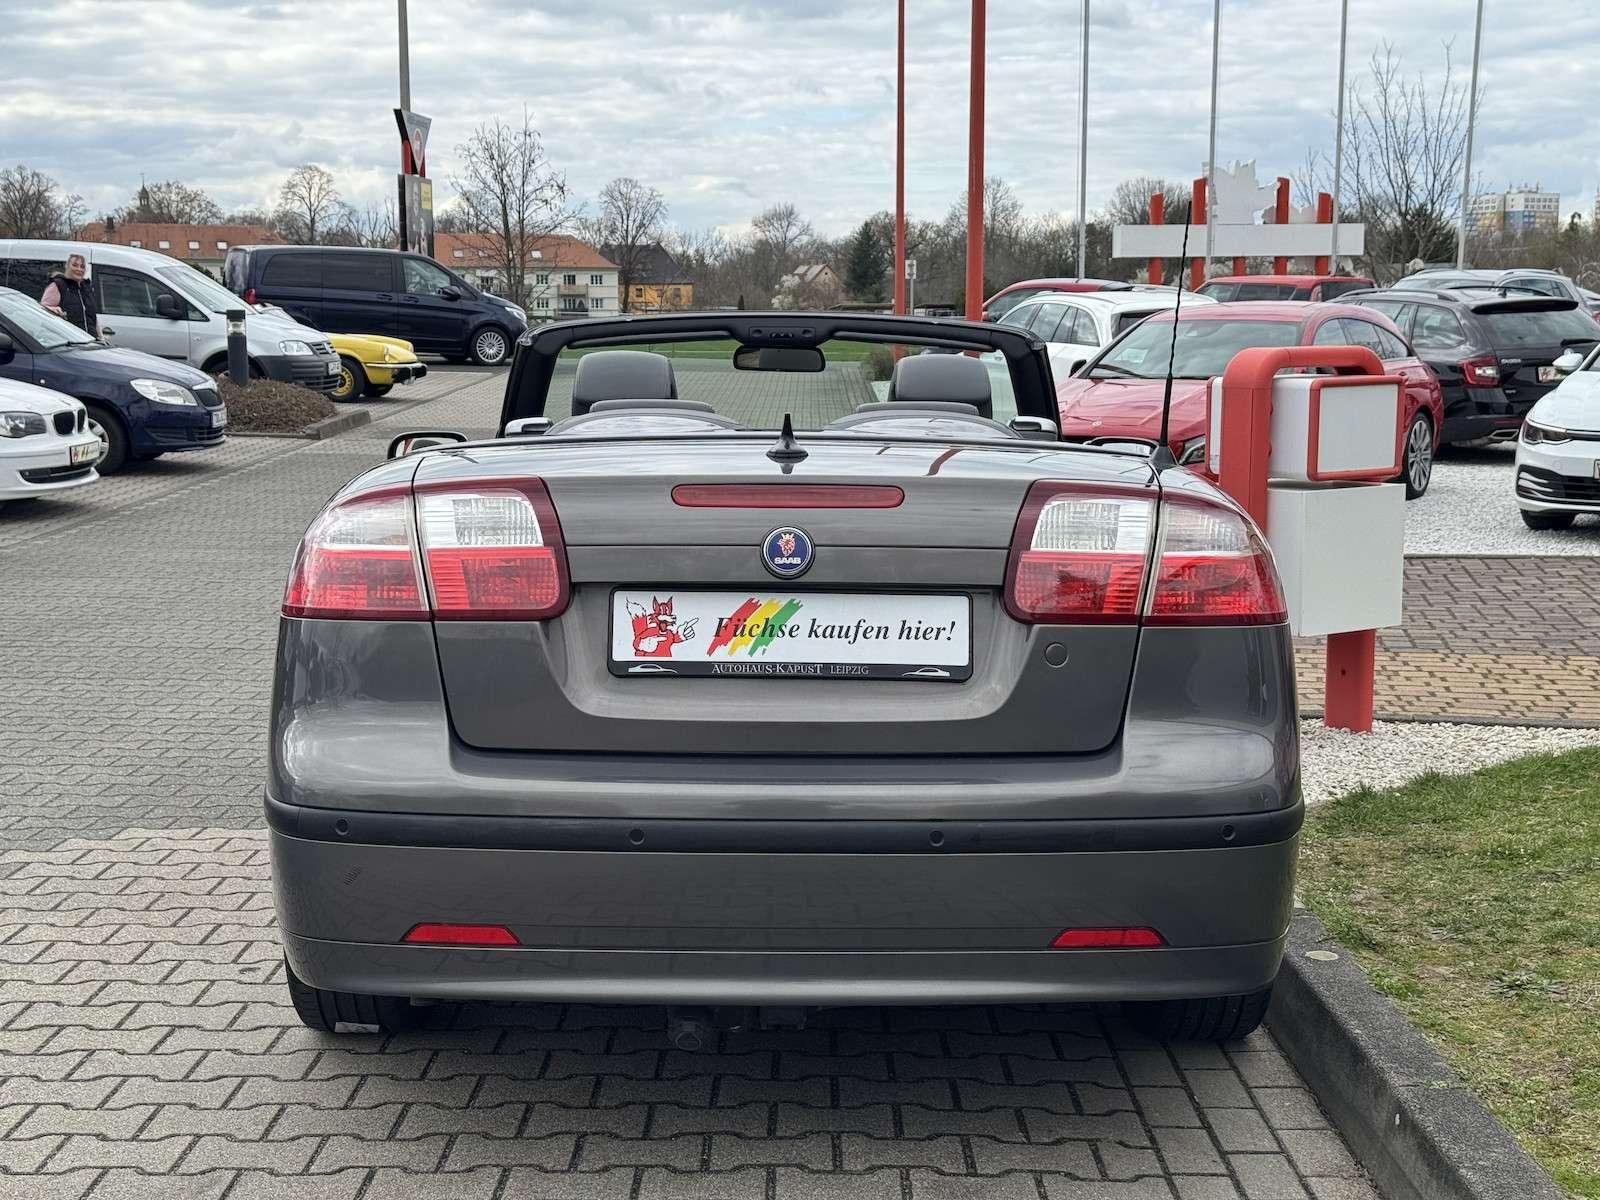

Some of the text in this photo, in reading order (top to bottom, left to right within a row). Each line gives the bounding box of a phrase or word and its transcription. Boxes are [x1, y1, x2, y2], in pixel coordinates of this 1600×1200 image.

[713, 617, 956, 644] Füchse kaufen hier!
[830, 665, 870, 675] LEIPZIG
